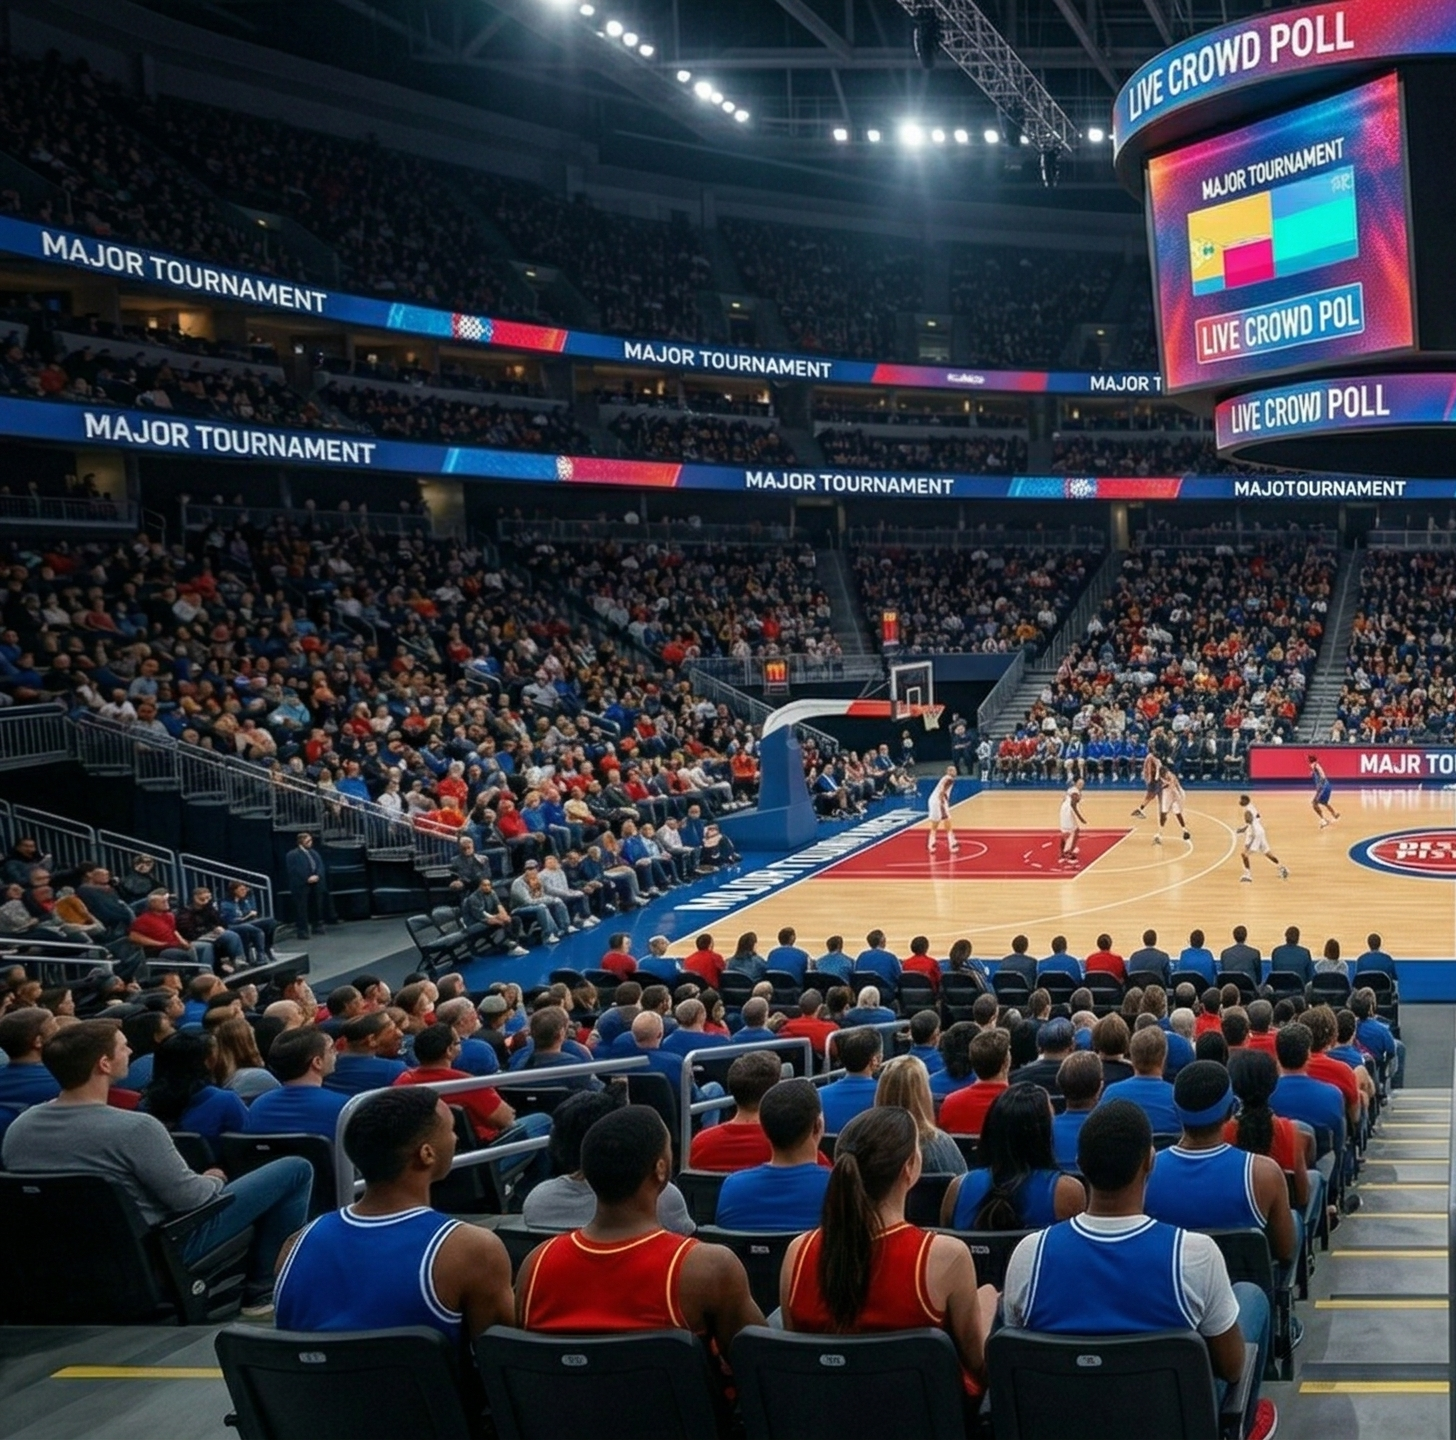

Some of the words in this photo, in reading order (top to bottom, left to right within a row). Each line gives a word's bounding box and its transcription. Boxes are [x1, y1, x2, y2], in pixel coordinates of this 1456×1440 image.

[1129, 69, 1164, 122] LIVE
[1168, 30, 1261, 95] CROWD
[1270, 11, 1354, 63] POLL
[1202, 169, 1247, 201] MAJOR
[1250, 138, 1344, 184] TOURNAMENT
[42, 231, 144, 277] MAJOR
[149, 256, 327, 313] TOURNAMENT
[1202, 320, 1240, 355] LIVE
[1244, 304, 1312, 347] CROWD
[1319, 294, 1360, 332] POL
[624, 341, 695, 366] MAJOR
[699, 350, 832, 378] TOURNAMENT
[1090, 375, 1150, 392] MAJOR
[1231, 401, 1261, 434] LIVE
[1328, 384, 1390, 420] POLL
[84, 412, 190, 449] MAJOR
[194, 425, 376, 464] TOURNAMENT
[746, 471, 816, 491] MAJOR
[819, 474, 954, 495] TOURNAMENT
[1360, 753, 1421, 774] MAJR
